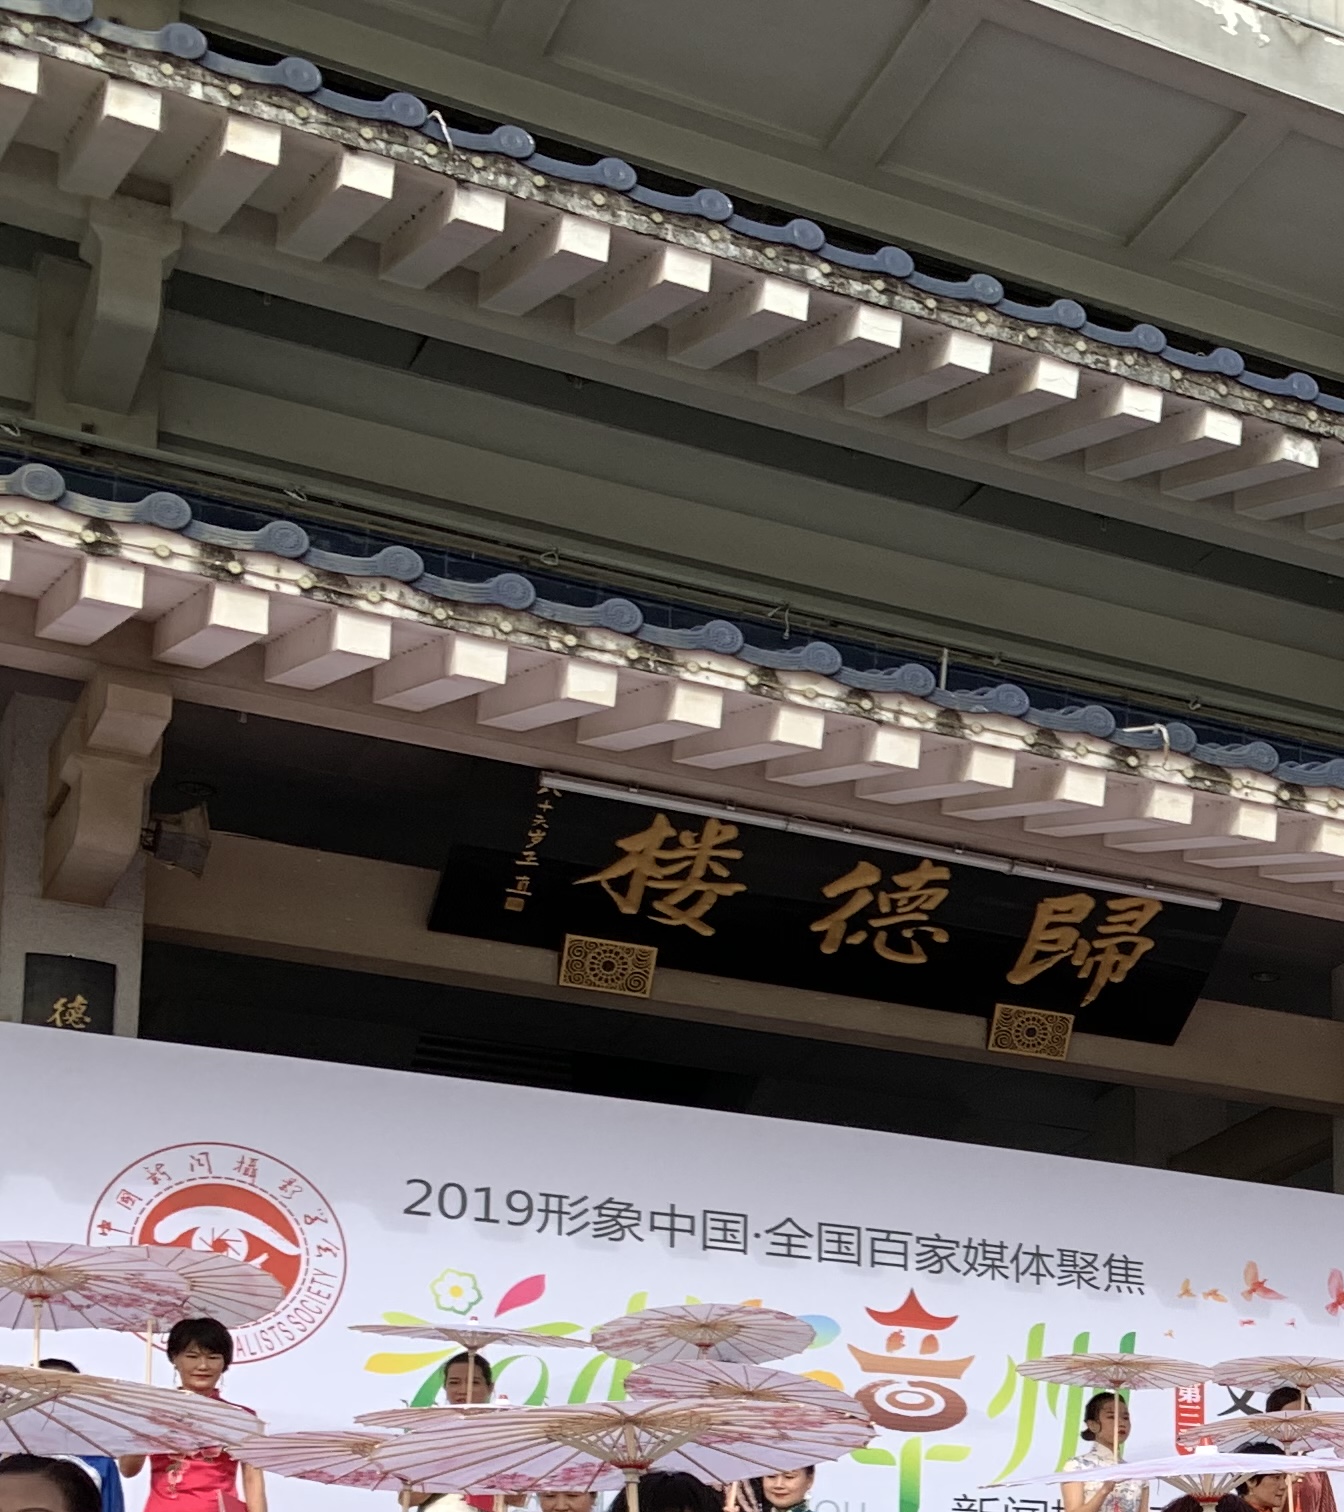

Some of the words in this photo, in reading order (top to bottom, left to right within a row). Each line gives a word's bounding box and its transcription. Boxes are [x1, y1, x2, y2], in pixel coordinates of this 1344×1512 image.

[402, 1178, 1146, 1296] 2019形象中国·全国百家媒体聚焦
[286, 1267, 339, 1334] SOCIETY
